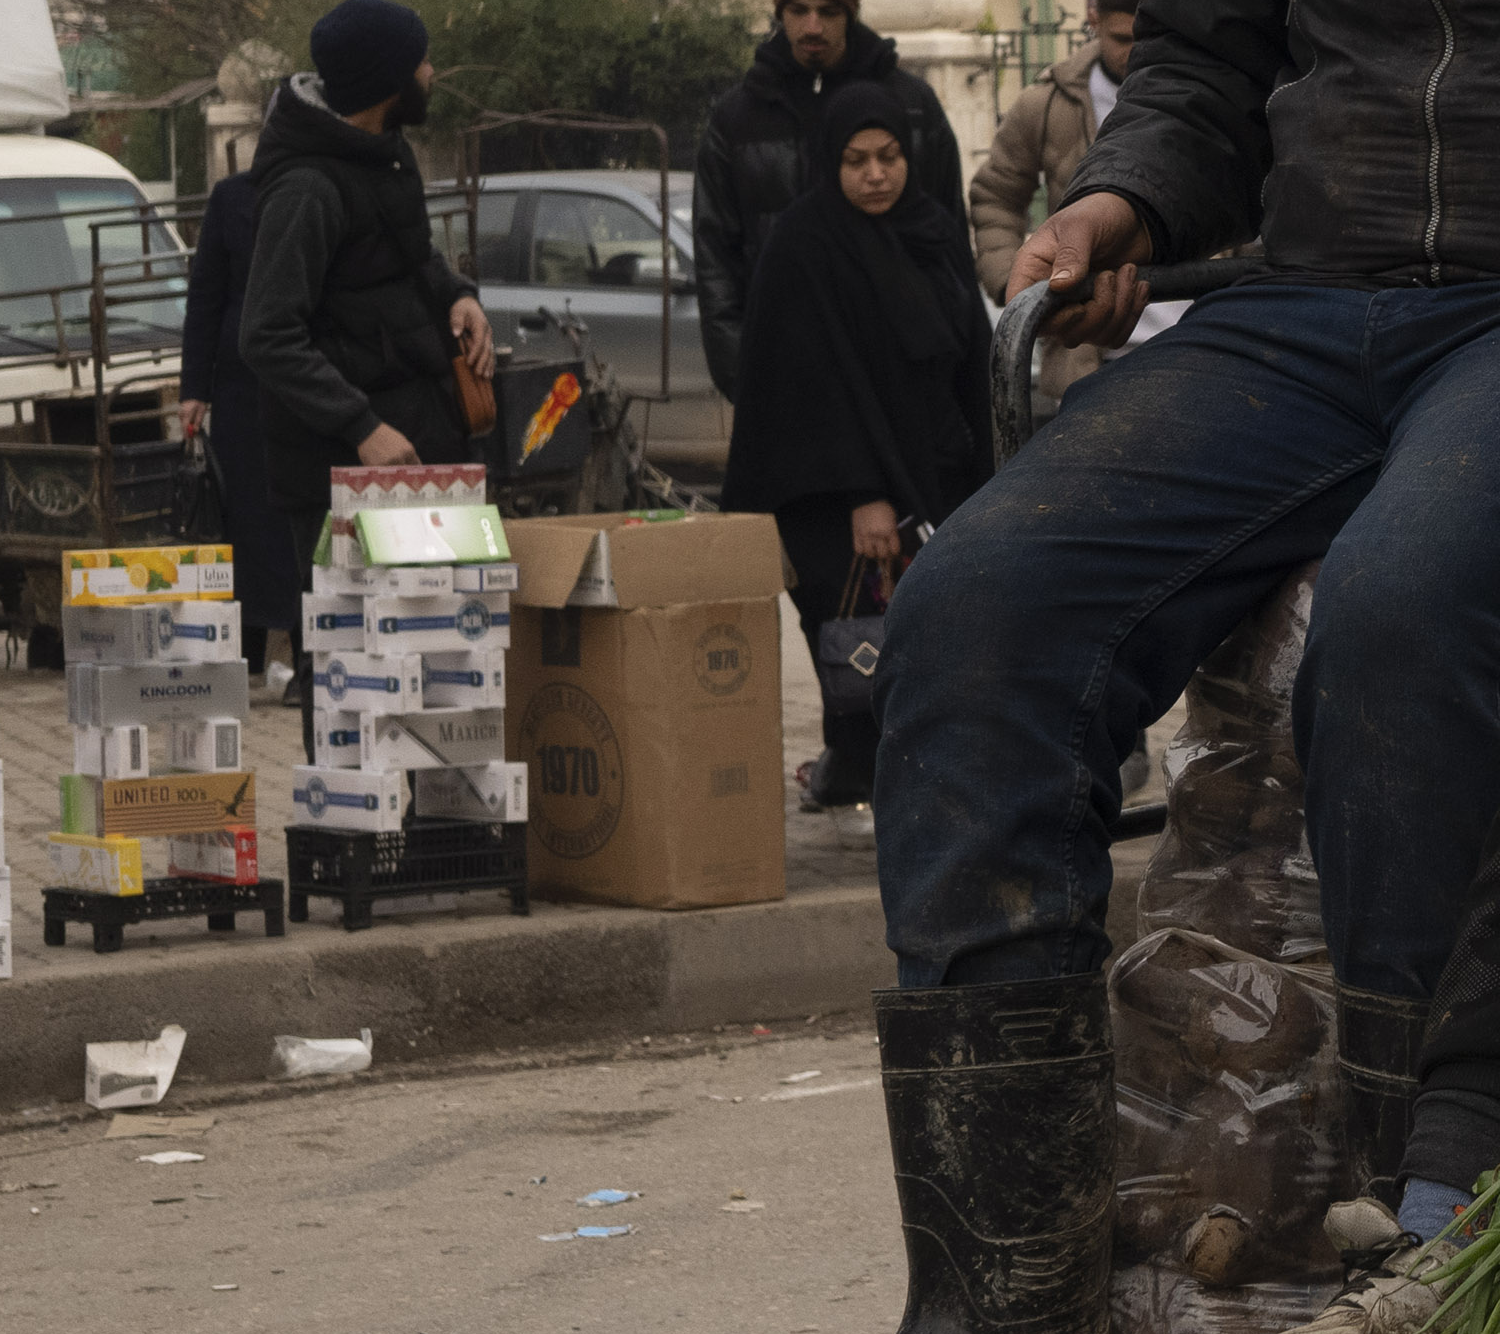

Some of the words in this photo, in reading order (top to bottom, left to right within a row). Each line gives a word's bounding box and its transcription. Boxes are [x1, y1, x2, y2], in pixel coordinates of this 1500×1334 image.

[706, 649, 739, 671] 1970
[140, 683, 212, 698] KINGDOM
[536, 743, 600, 797] 1970
[113, 786, 170, 805] UNITED
[177, 787, 208, 802] 100's
